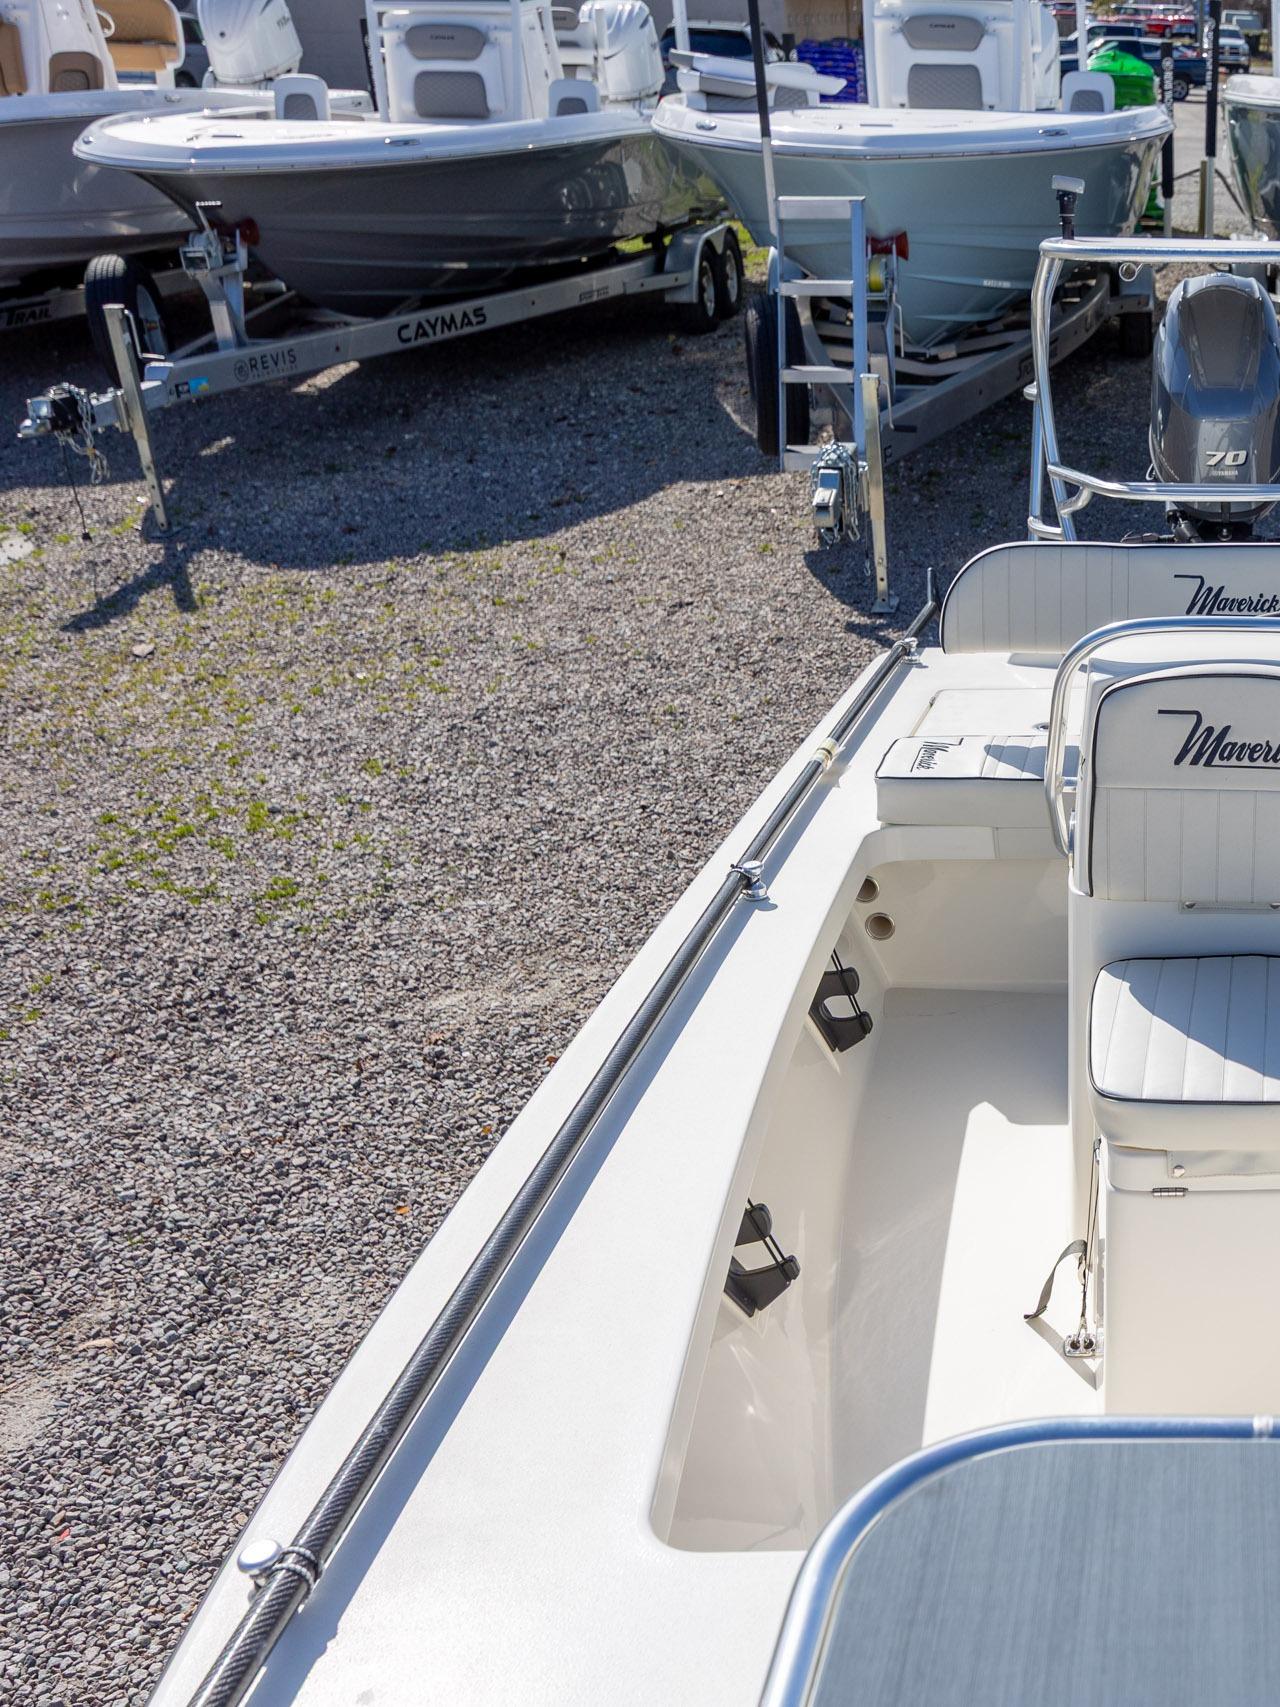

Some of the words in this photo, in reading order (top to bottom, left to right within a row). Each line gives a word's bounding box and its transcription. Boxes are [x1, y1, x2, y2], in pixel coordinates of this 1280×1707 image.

[397, 307, 487, 344] CAYMAS
[250, 349, 297, 372] REVIS
[1206, 450, 1248, 467] 70
[1174, 574, 1280, 616] Maverick
[911, 738, 964, 771] Maverick
